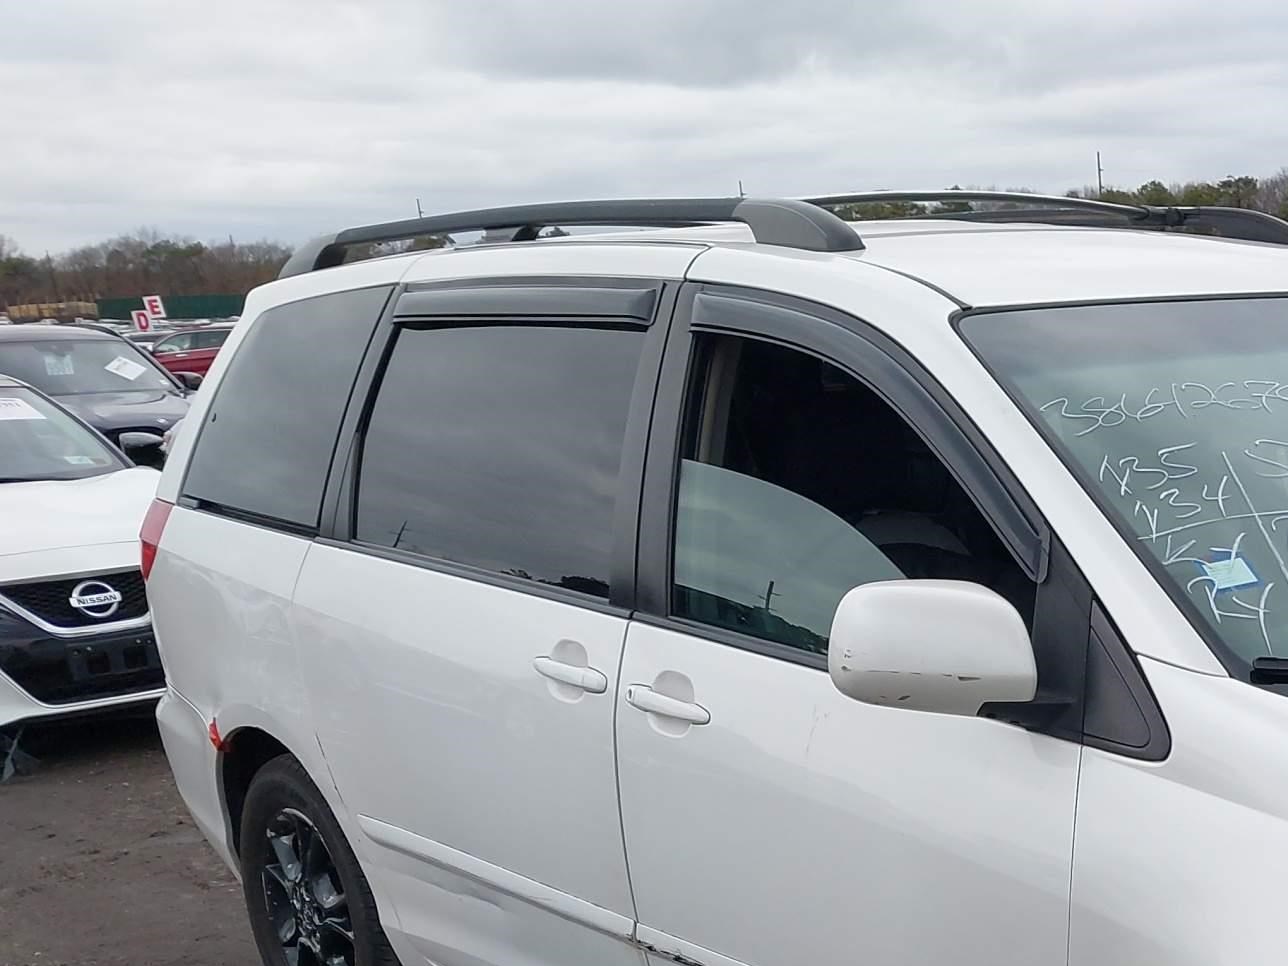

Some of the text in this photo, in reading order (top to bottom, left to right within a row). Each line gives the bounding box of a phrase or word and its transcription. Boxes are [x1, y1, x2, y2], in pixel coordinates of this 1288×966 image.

[147, 299, 161, 315] E
[136, 312, 149, 330] D
[76, 594, 118, 605] NISSAN
